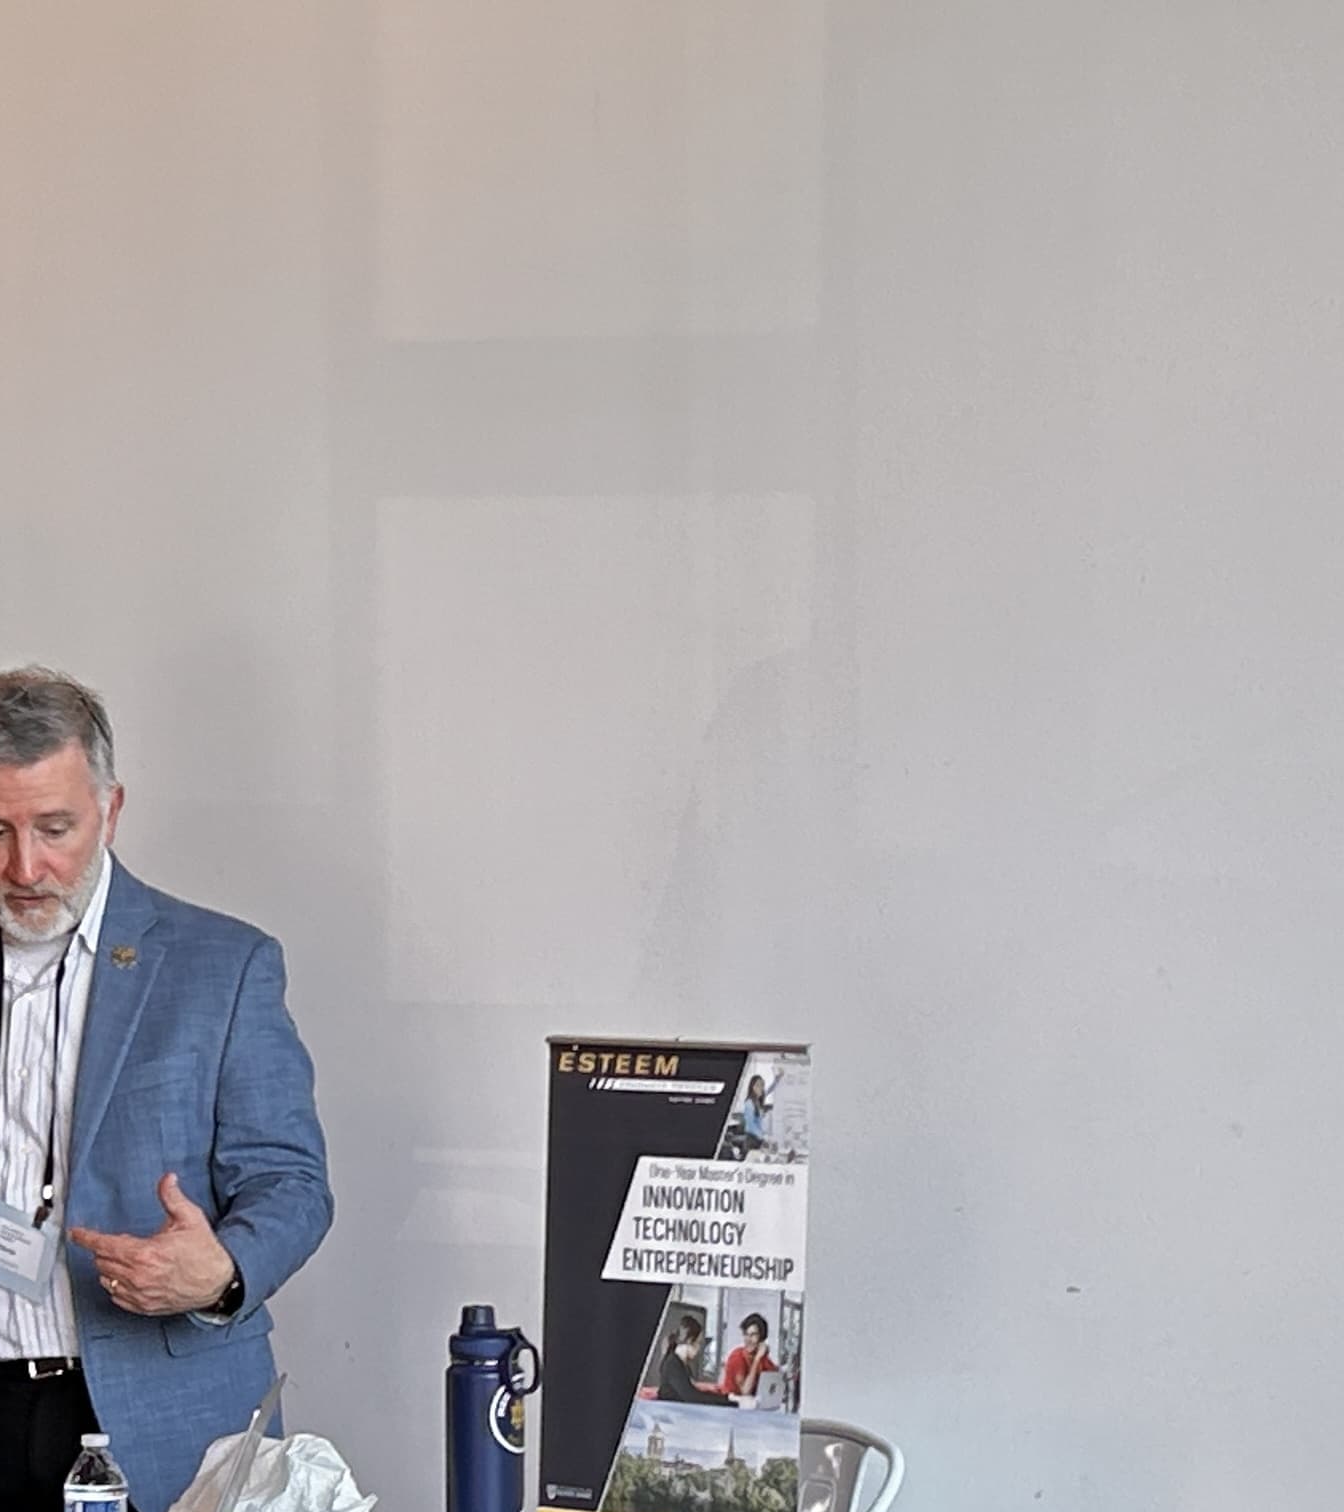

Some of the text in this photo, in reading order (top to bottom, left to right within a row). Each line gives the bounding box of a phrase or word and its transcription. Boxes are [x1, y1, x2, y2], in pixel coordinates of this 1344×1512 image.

[558, 1052, 679, 1076] ESTEEM
[642, 1185, 745, 1214] INNOVATION
[633, 1216, 747, 1246] TECHNOLOGY
[622, 1247, 795, 1281] ENTREPRENEURSHIP
